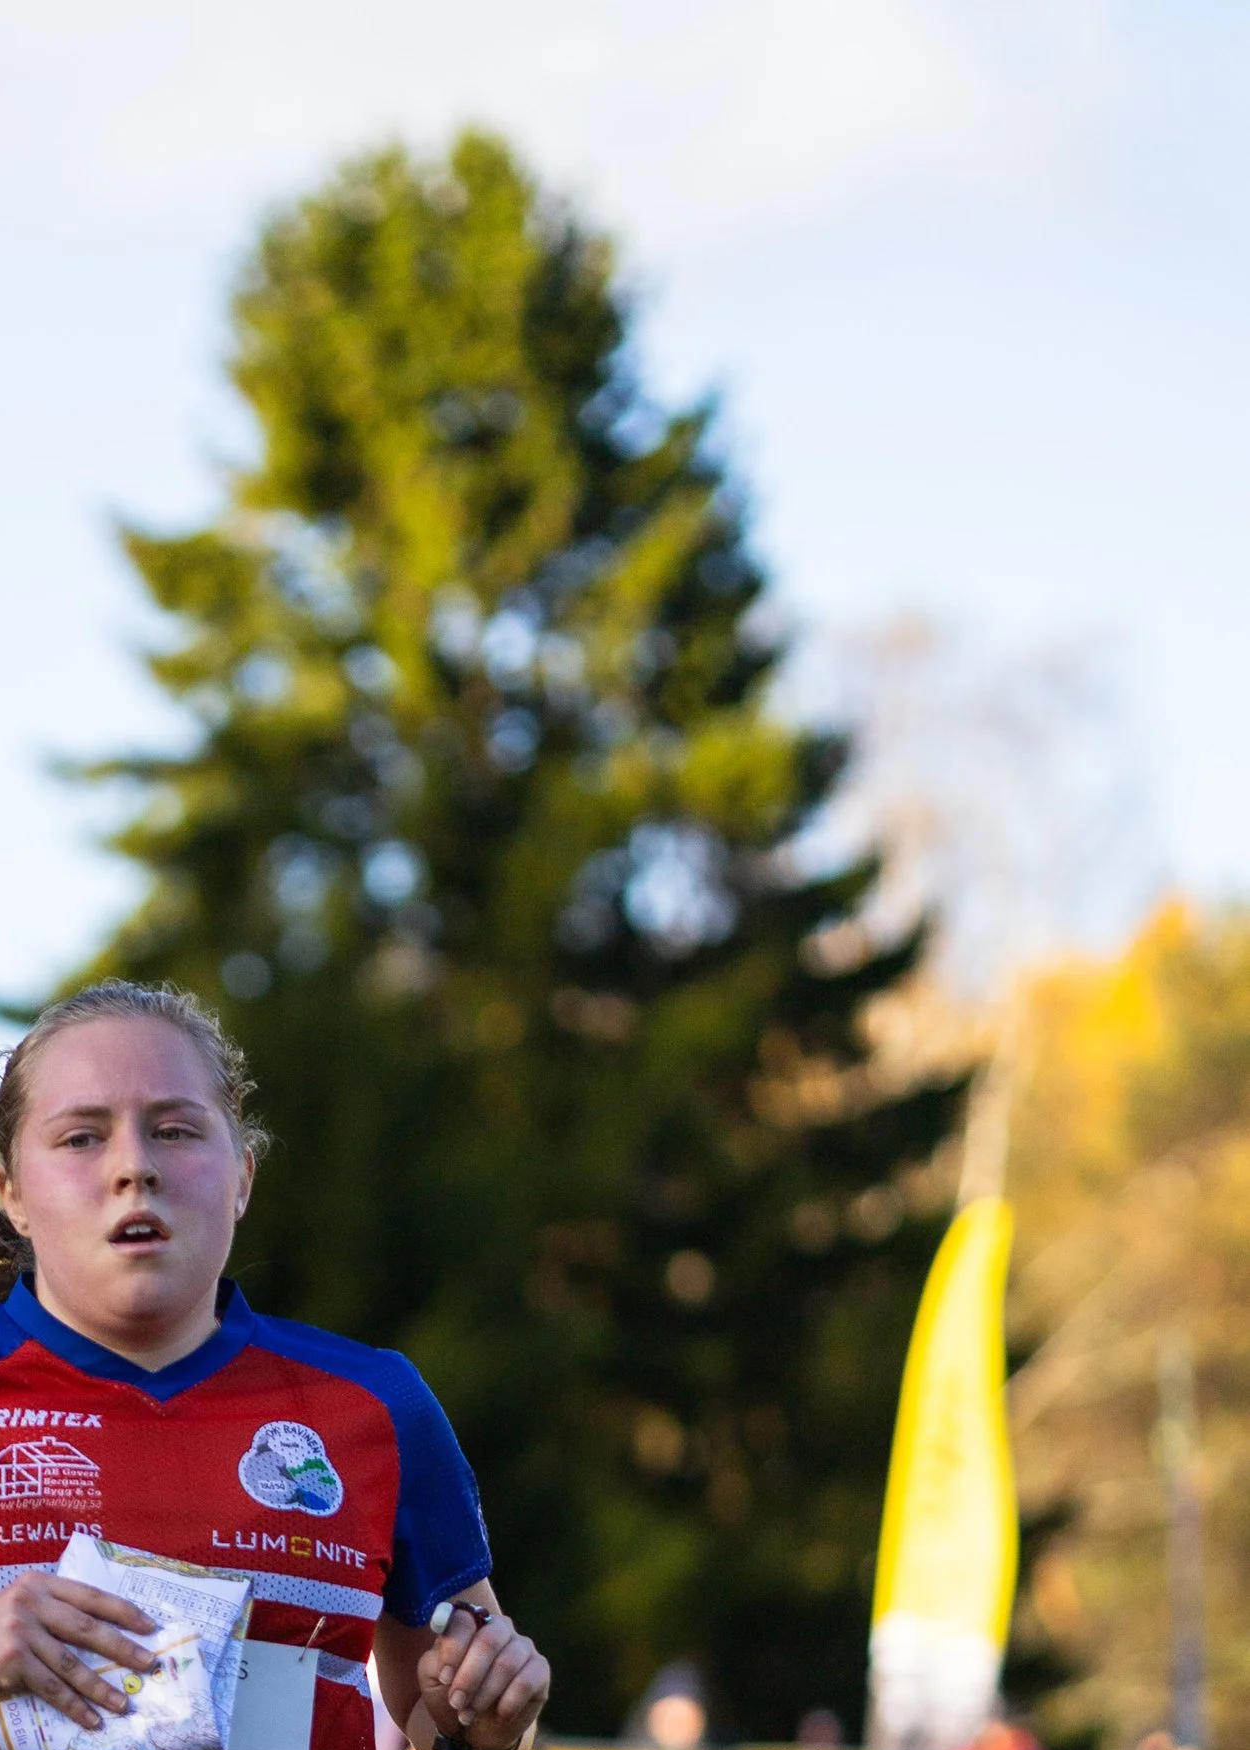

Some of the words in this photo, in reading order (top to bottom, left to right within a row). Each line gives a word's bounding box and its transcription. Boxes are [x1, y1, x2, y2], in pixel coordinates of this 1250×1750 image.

[283, 1424, 321, 1454] RAVINEN
[43, 1467, 59, 1476] AB
[43, 1486, 72, 1497] Bygg
[87, 1488, 102, 1497] Co
[212, 1529, 368, 1570] LUMONITE
